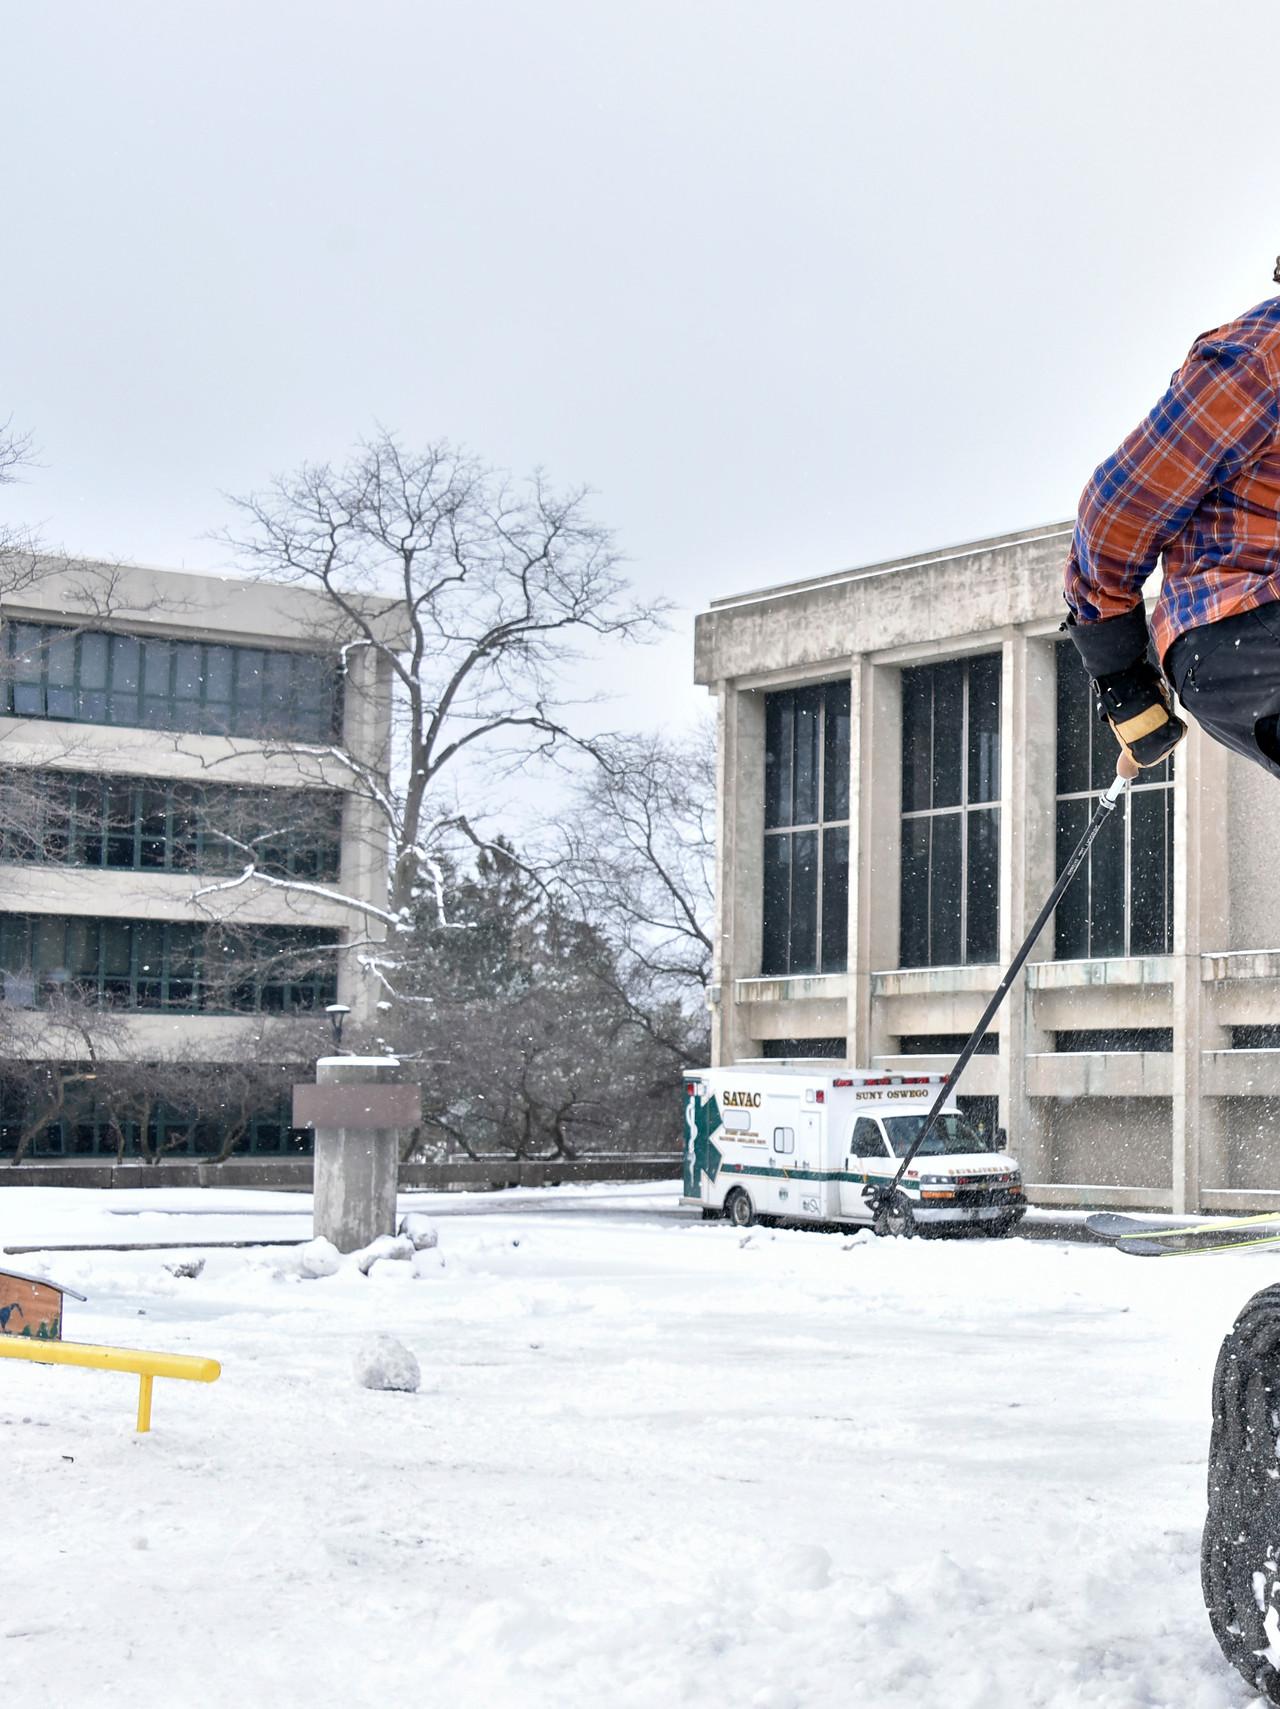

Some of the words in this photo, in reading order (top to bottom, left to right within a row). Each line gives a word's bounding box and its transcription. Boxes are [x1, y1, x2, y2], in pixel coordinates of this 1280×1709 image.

[723, 1091, 761, 1108] SAVAC
[856, 1091, 883, 1100] SUNY
[887, 1089, 928, 1099] OSWEGO
